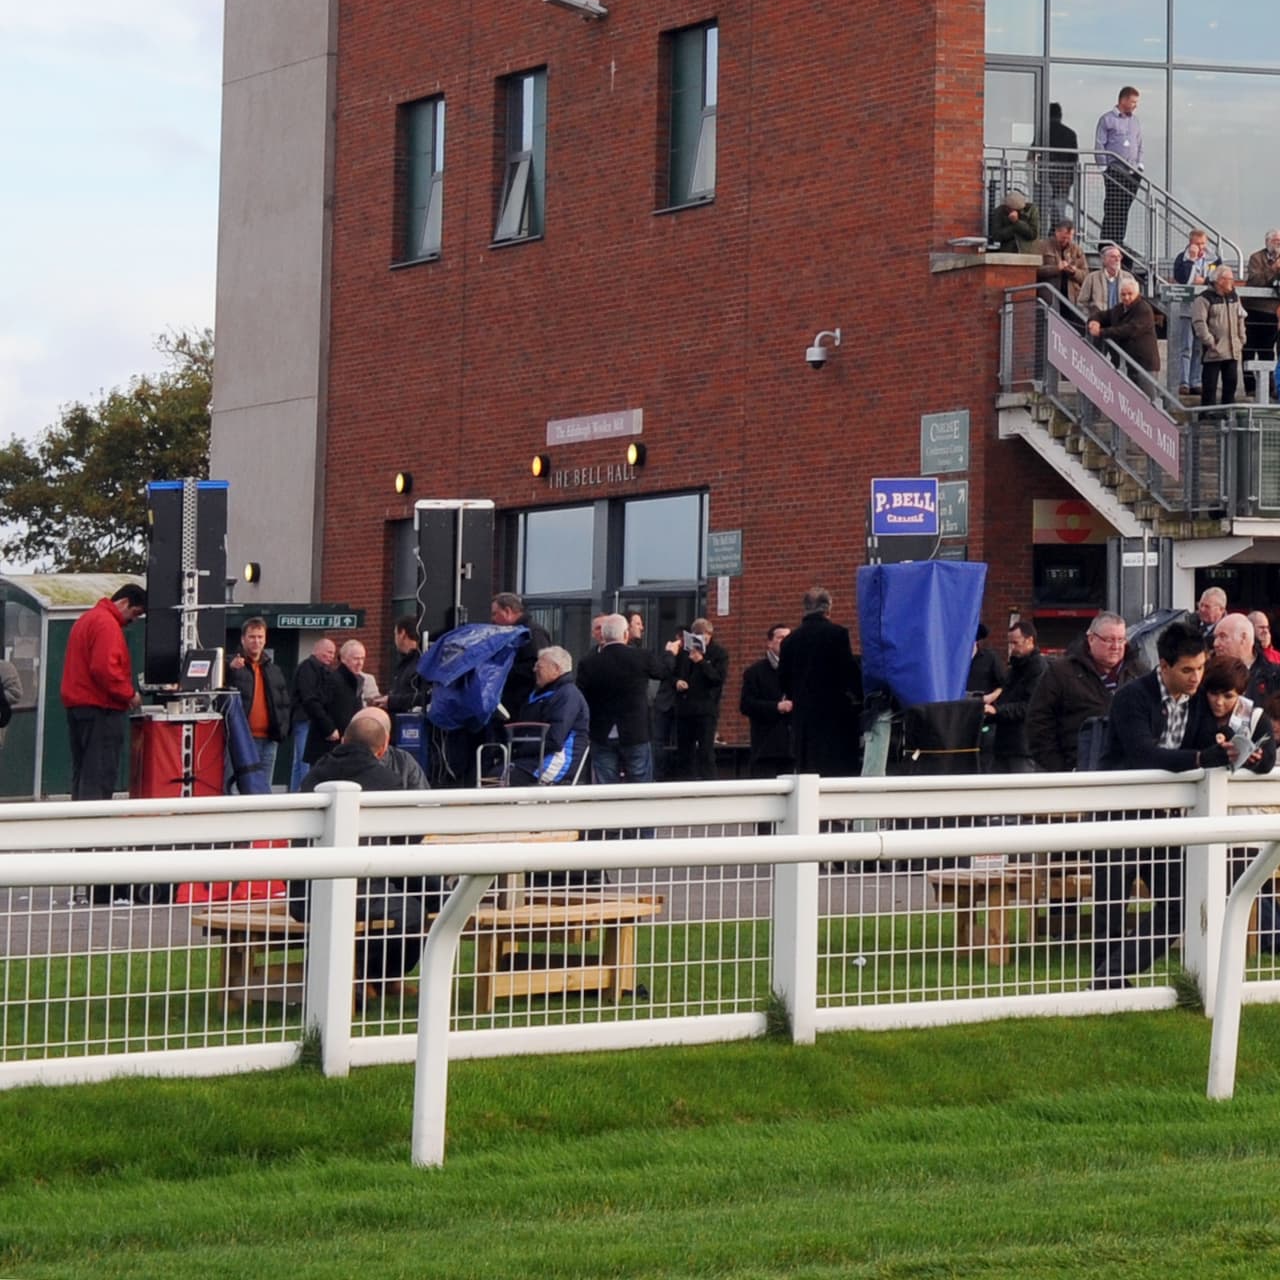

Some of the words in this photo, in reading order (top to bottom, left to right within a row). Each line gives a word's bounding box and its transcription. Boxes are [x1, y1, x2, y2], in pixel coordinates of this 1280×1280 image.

[1052, 330, 1067, 360] The
[1071, 349, 1114, 405] Edinburgh
[1118, 391, 1152, 440] Woollen
[1157, 427, 1176, 462] Mill
[574, 466, 602, 486] BELL
[607, 463, 636, 484] HALL
[892, 492, 935, 513] BELL
[281, 616, 304, 626] FIRE
[305, 616, 326, 626] EXIT
